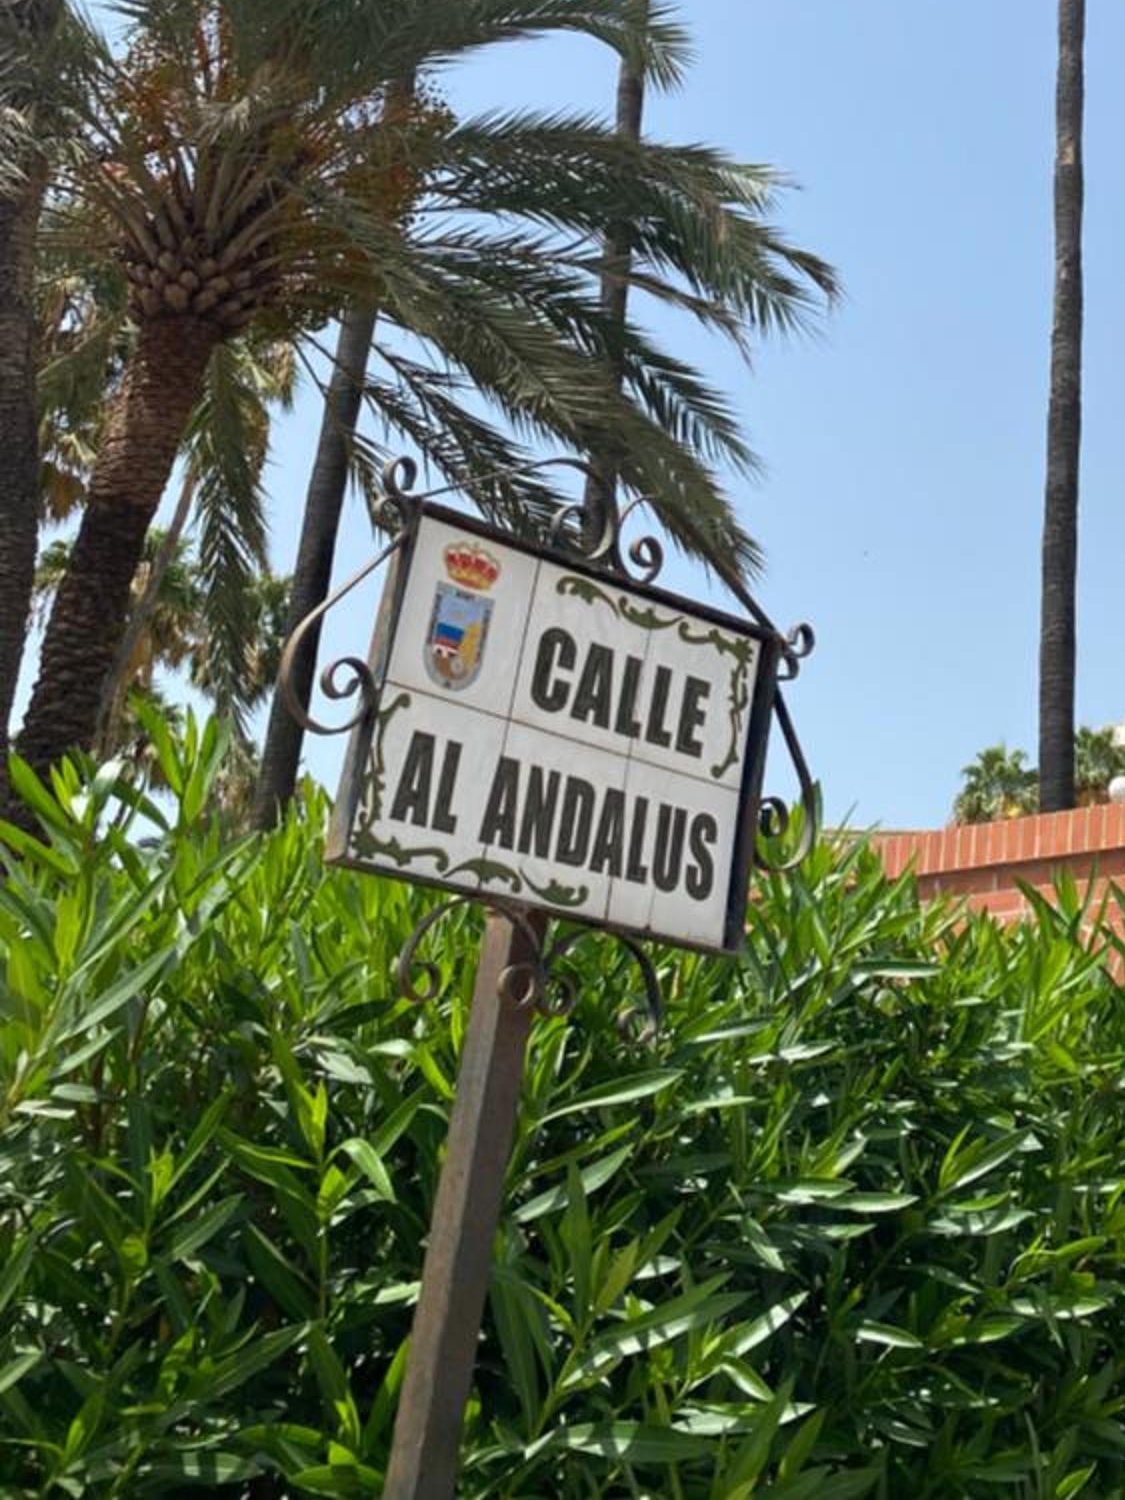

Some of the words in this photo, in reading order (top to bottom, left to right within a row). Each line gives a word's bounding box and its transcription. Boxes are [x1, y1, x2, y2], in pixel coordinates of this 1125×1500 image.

[530, 627, 711, 758] CALLE
[389, 731, 464, 834] AL
[479, 756, 719, 901] ANDALUS
